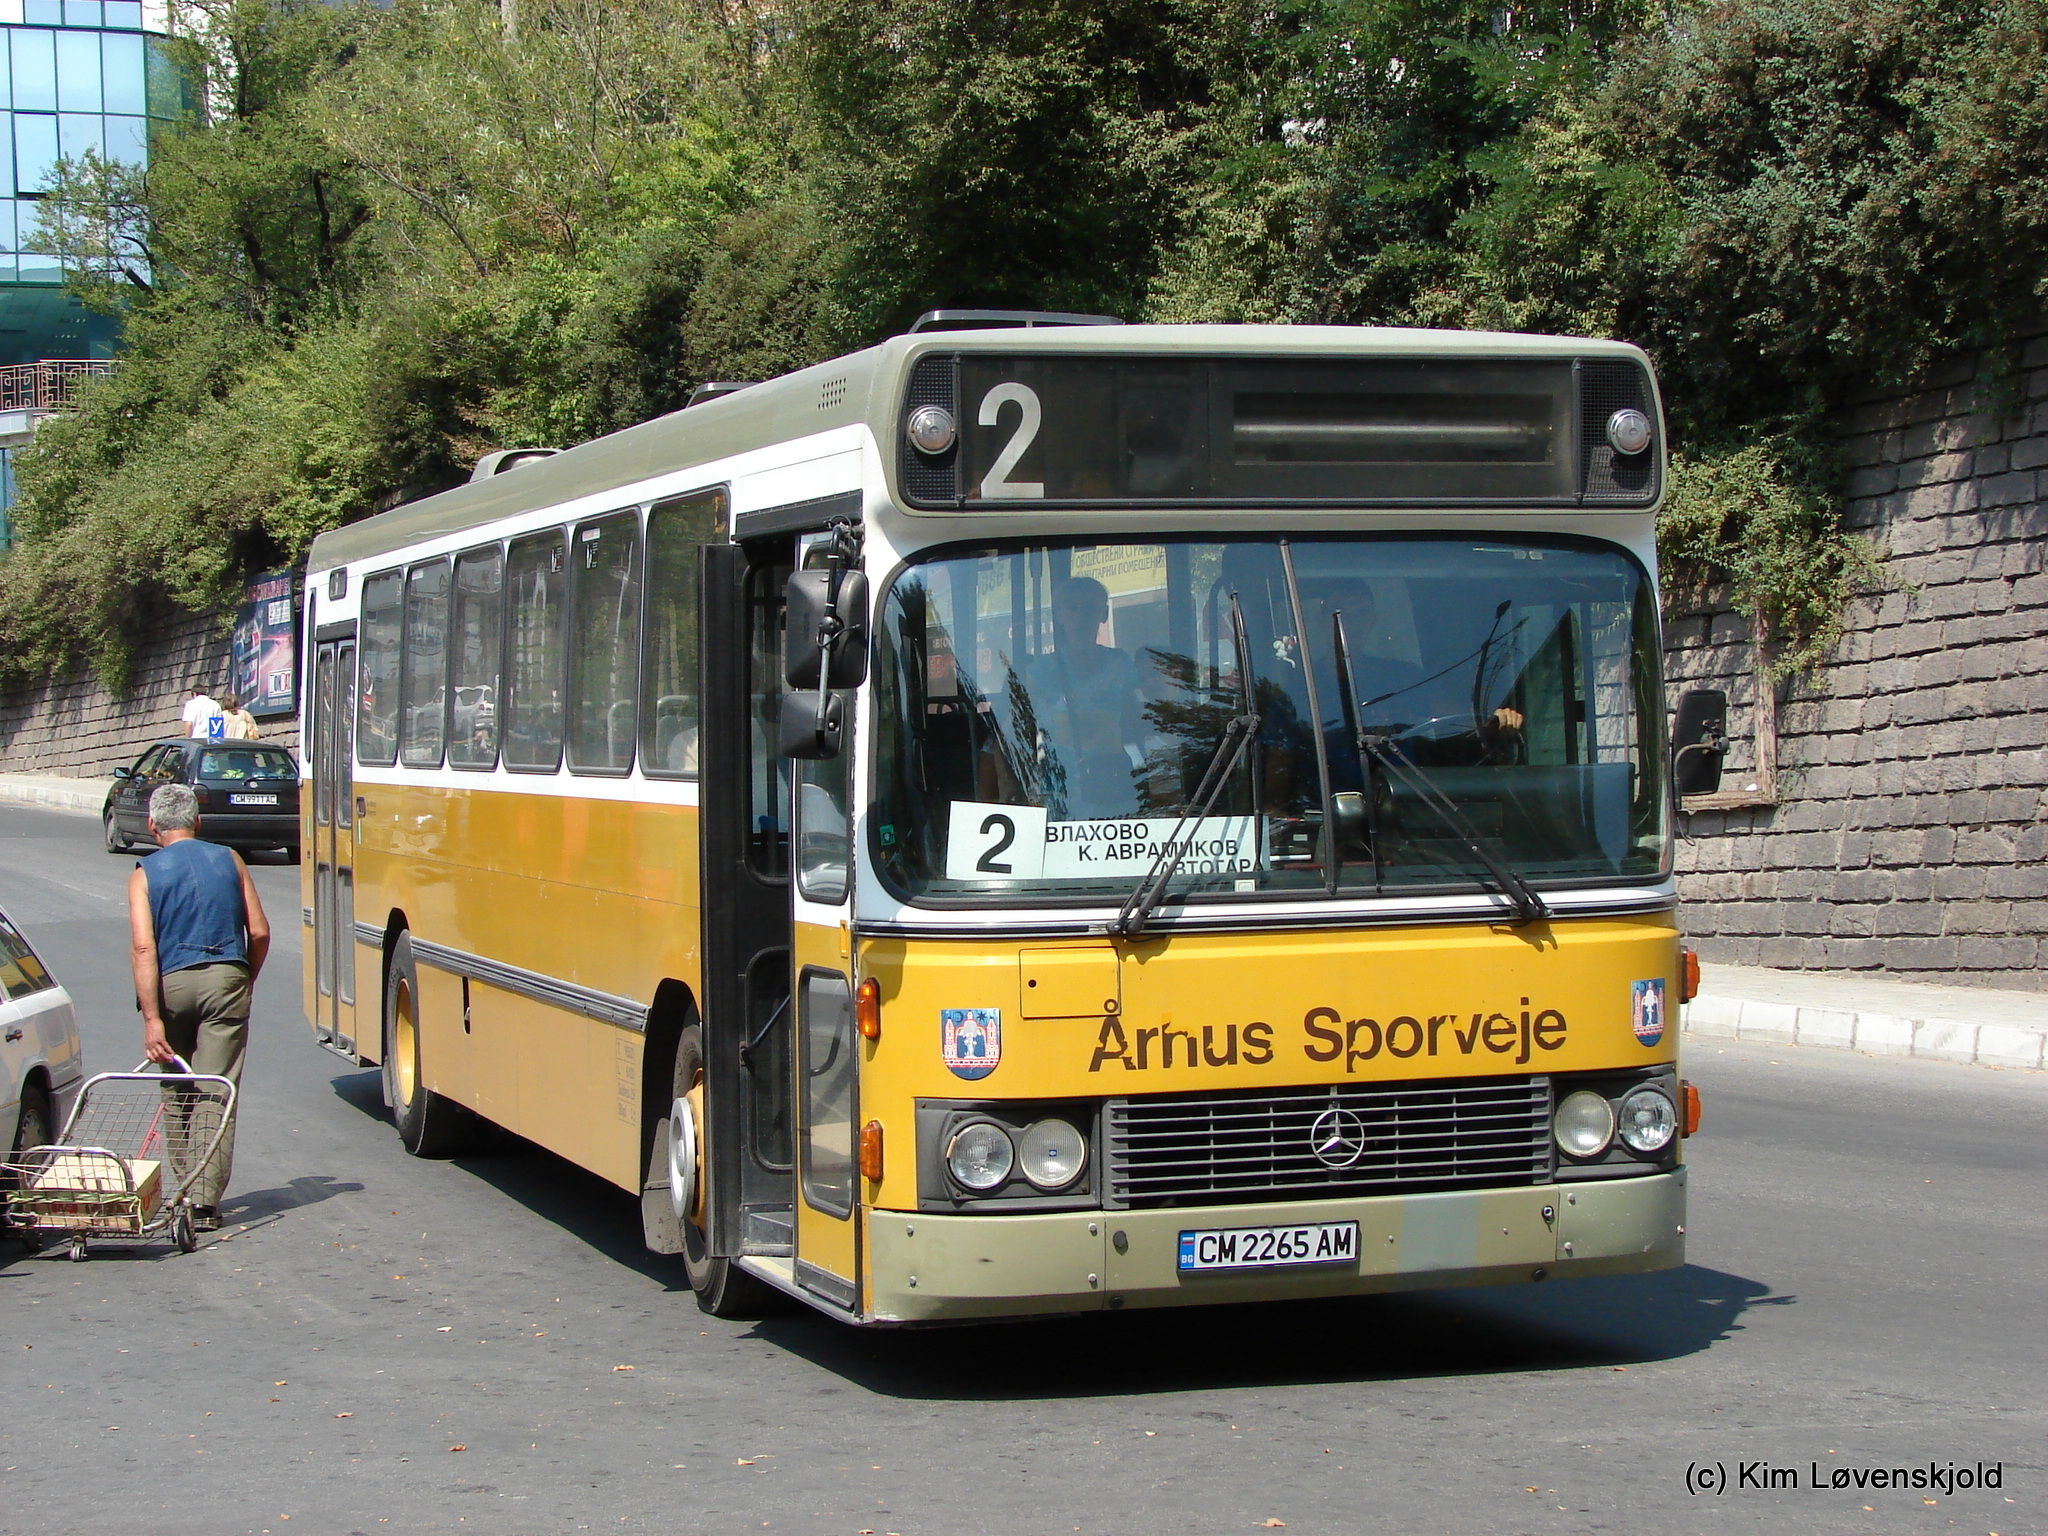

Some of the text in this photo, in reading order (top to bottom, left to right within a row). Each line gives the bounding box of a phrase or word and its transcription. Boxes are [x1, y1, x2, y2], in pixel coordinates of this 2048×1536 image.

[978, 382, 1045, 499] 2
[976, 813, 1015, 874] 2
[1046, 823, 1149, 843] ВЛАХОВО
[1078, 844, 1098, 861] К.
[1303, 997, 1567, 1073] Sporveje
[1181, 1254, 1194, 1264] BG
[1242, 1230, 1309, 1262] 2265
